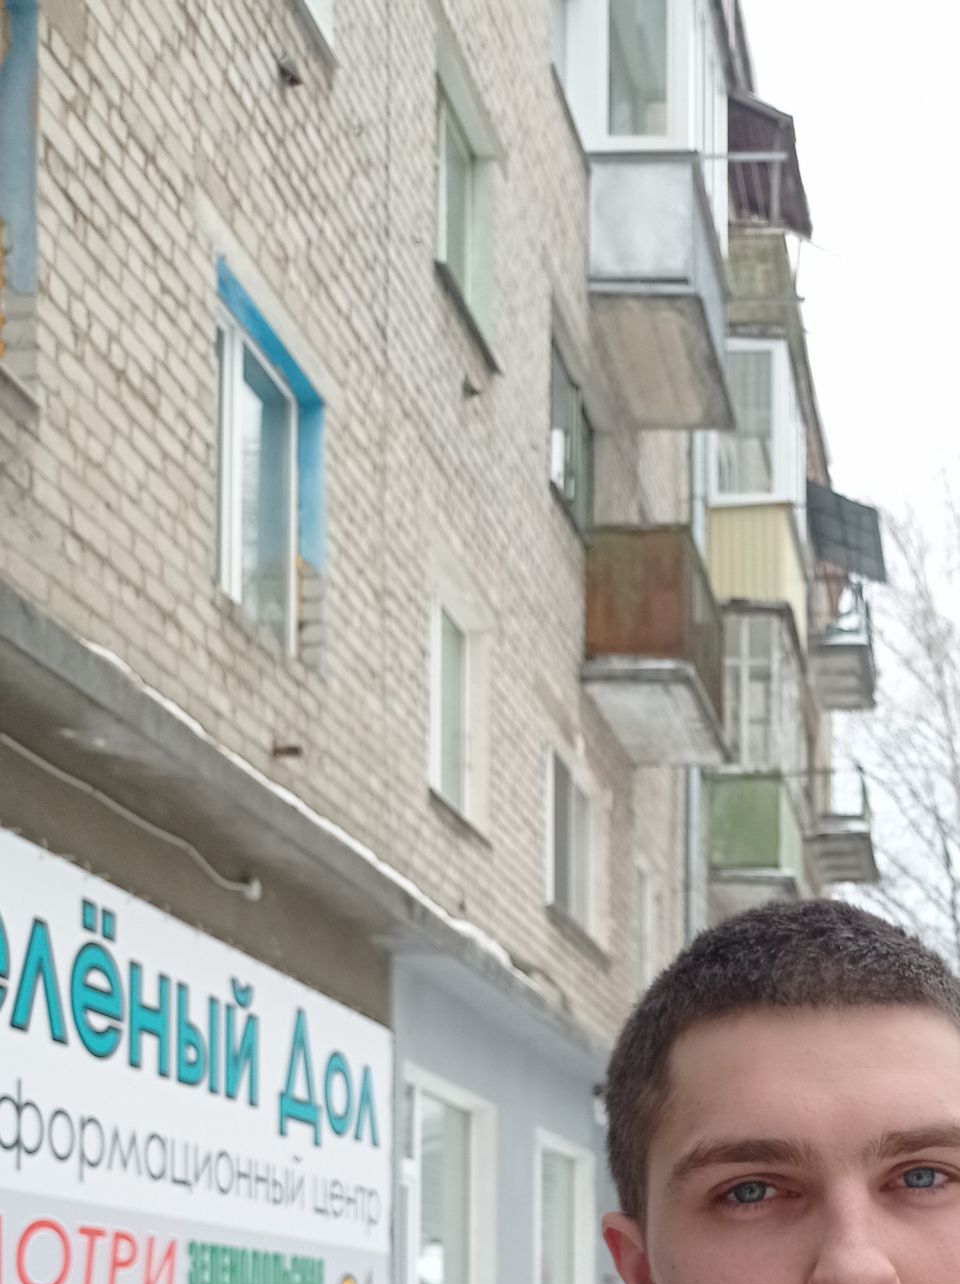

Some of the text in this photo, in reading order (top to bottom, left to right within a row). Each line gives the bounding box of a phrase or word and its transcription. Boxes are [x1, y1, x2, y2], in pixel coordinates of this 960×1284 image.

[0, 898, 380, 1148] лёный Дол
[0, 1078, 382, 1235] формационный центр
